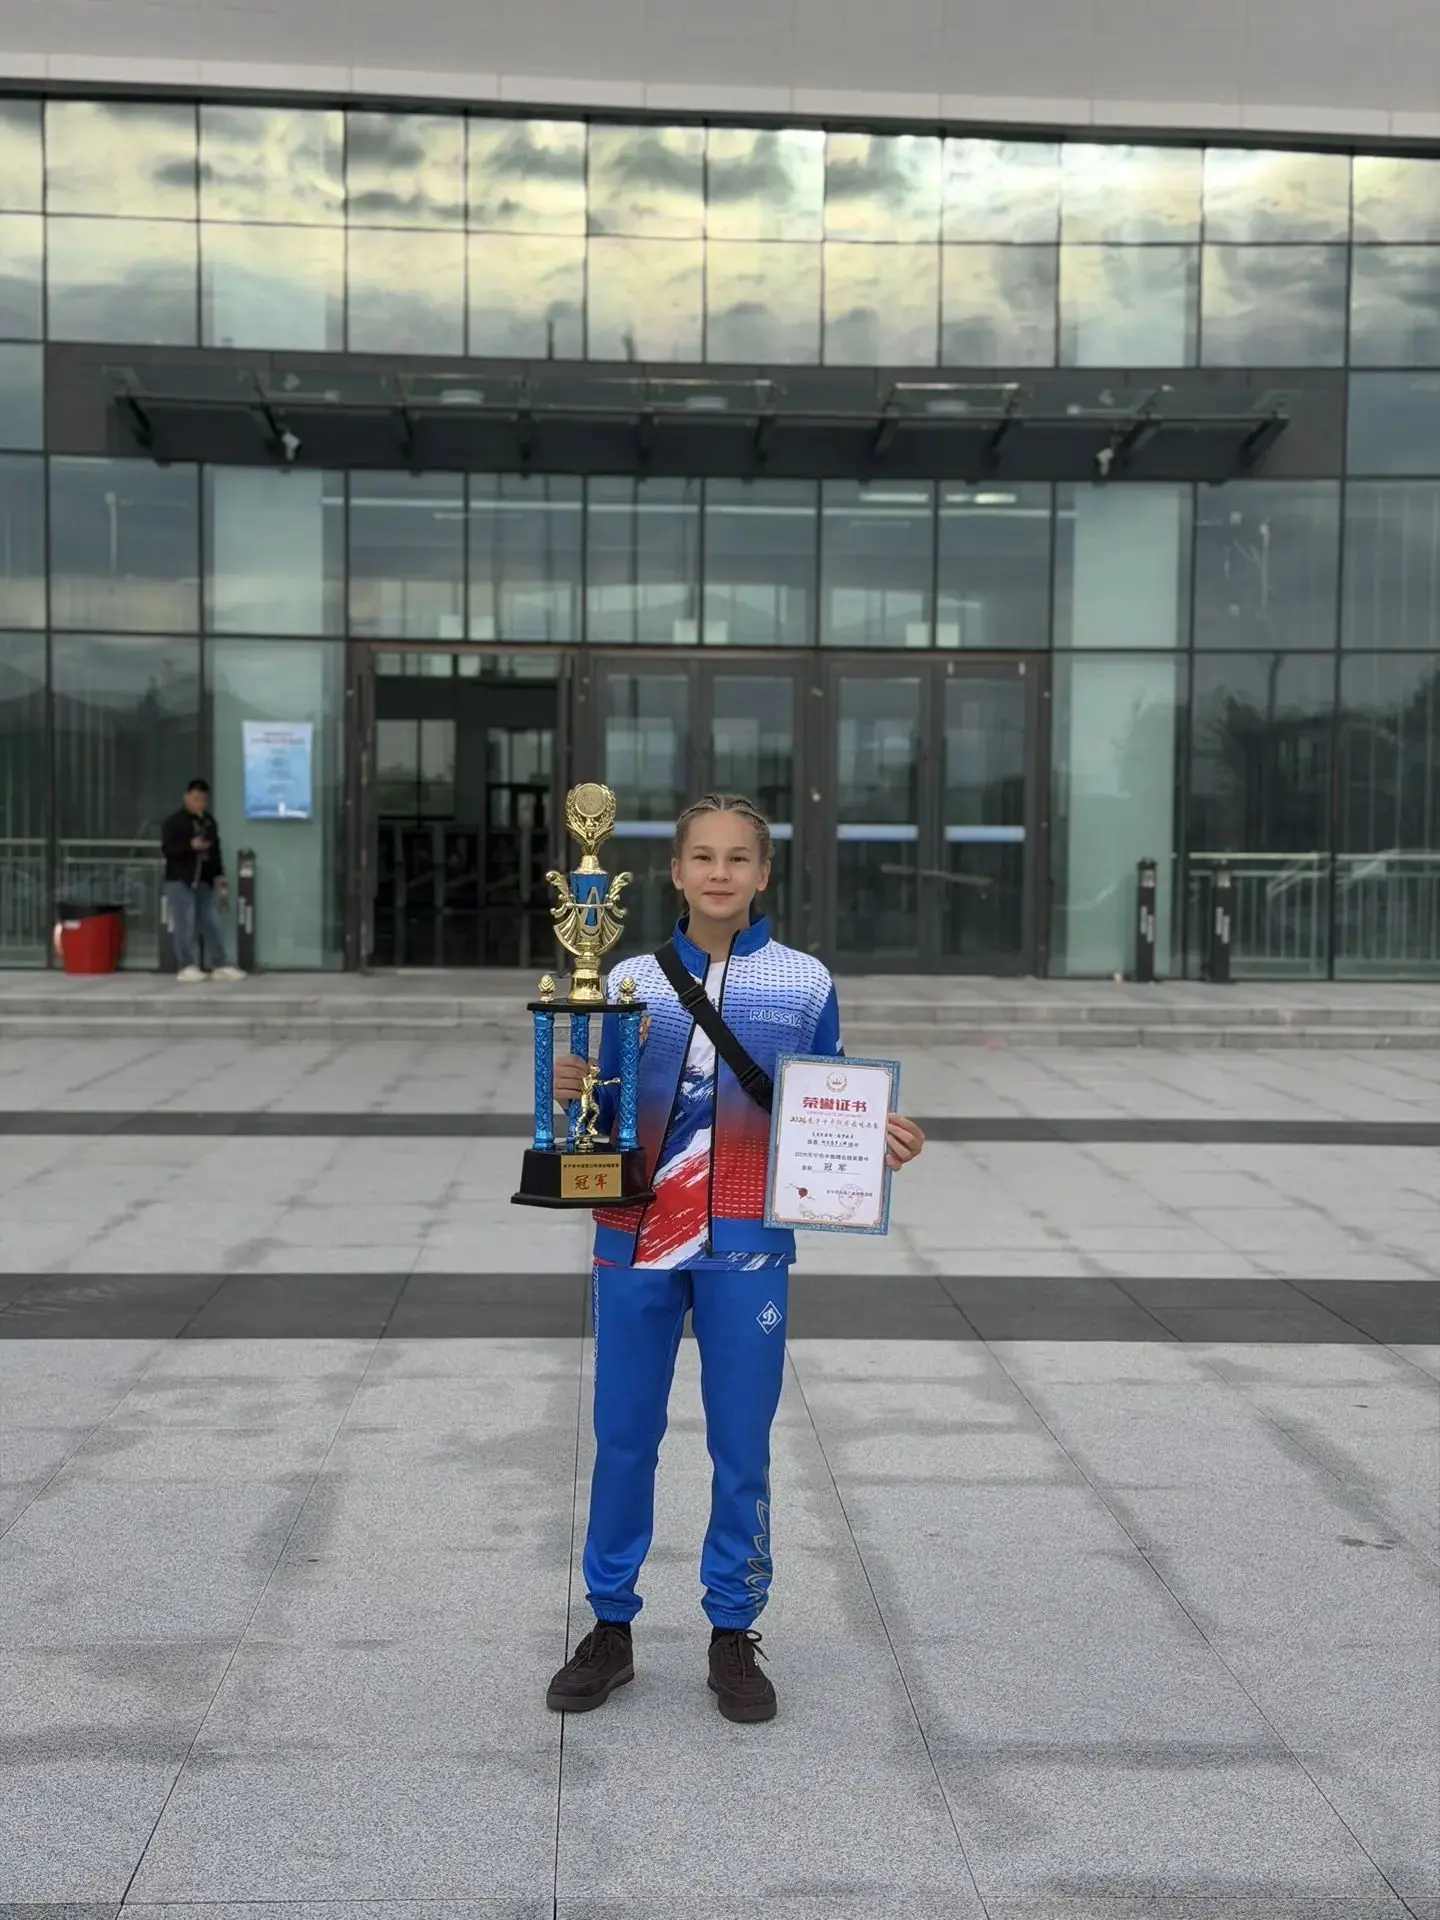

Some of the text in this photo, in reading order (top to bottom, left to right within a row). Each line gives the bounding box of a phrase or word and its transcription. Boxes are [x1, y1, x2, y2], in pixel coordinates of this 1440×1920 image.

[750, 1009, 803, 1028] RUSSIA
[802, 1096, 868, 1113] 荣誉证书
[574, 1173, 608, 1191] 冠军
